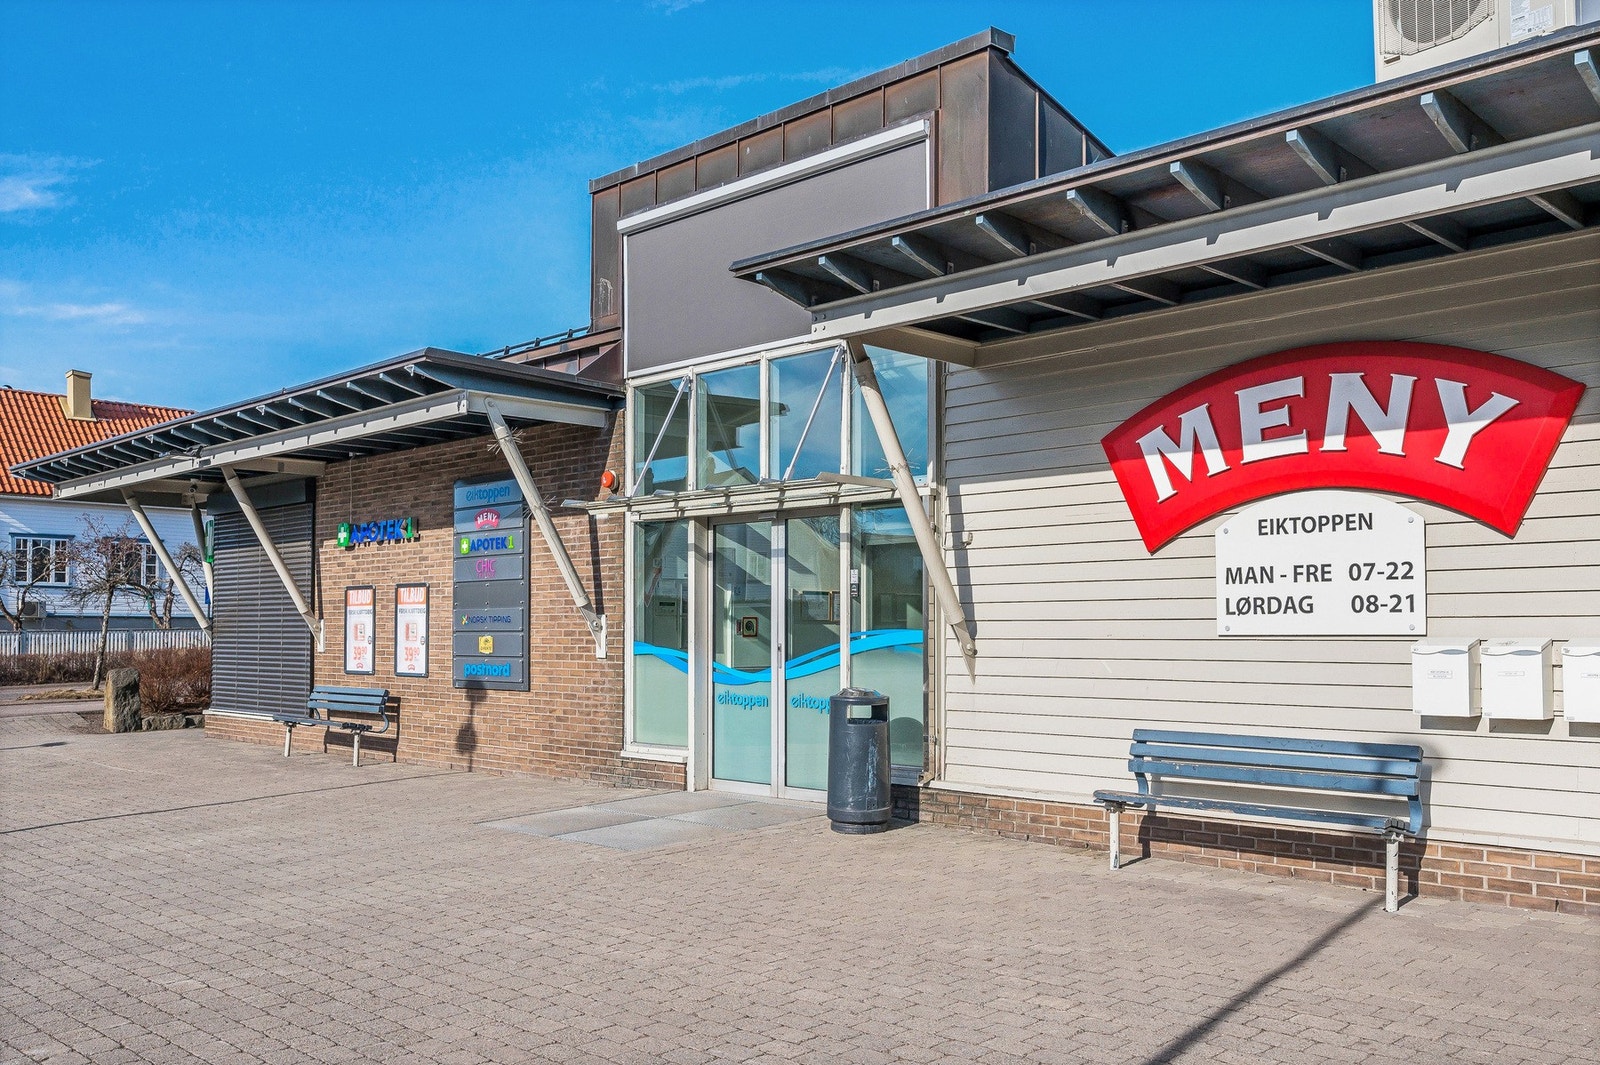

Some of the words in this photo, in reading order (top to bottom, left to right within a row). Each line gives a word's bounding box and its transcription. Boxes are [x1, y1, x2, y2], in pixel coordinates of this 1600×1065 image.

[1135, 372, 1521, 504] MENY
[466, 485, 511, 503] eiktoppen
[477, 512, 497, 525] MENY
[1257, 512, 1374, 536] EIKTOPPEN
[475, 559, 496, 573] CHIC
[1225, 565, 1275, 586] MAN
[1293, 563, 1334, 584] FRE
[1348, 561, 1415, 582] 07-22
[400, 587, 425, 602] TILBUD
[1225, 594, 1315, 618] LØRDAG
[1351, 593, 1416, 614] 08-21
[469, 614, 488, 624] NORSK
[489, 614, 512, 623] TIPPING
[464, 662, 510, 677] postnord
[717, 690, 769, 710] eiktoppen
